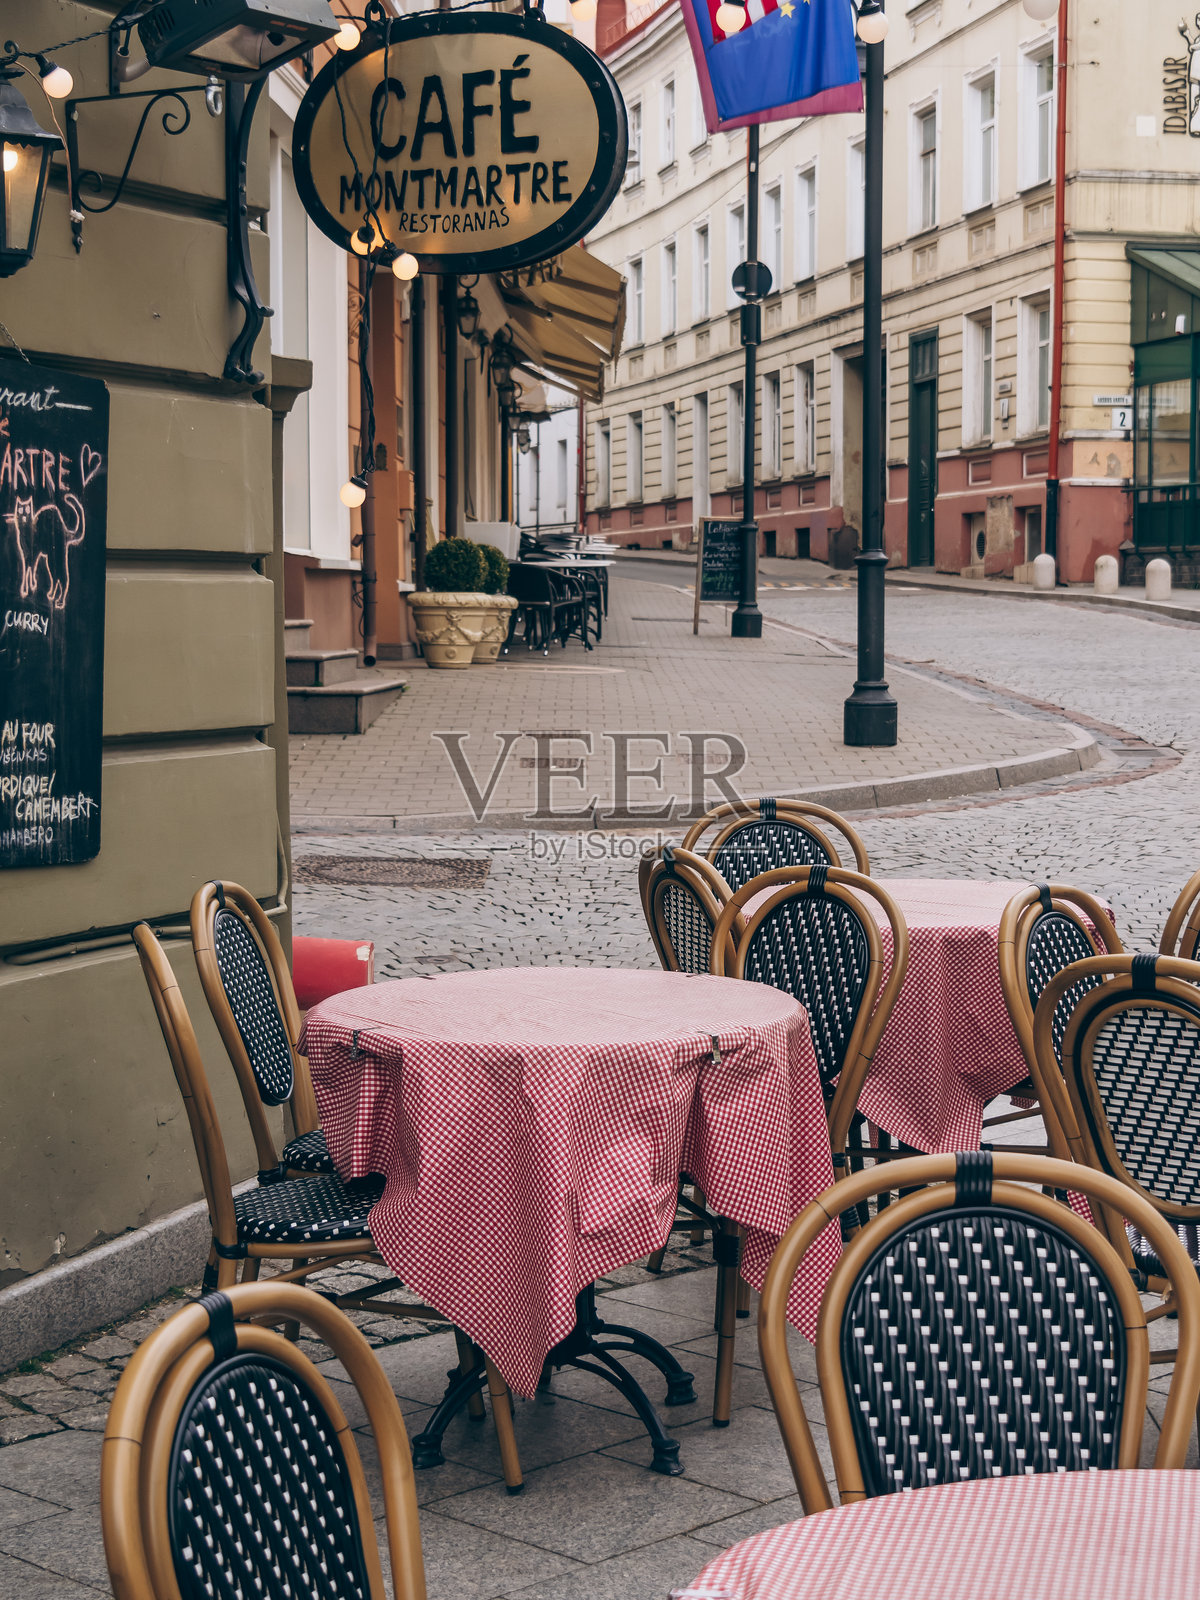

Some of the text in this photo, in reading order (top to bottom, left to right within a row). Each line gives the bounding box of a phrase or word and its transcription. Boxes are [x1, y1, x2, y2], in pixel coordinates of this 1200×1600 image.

[370, 54, 539, 162] CAFÉ
[338, 160, 573, 214] MONTMARTRE
[398, 206, 511, 234] RESTORANAS
[1119, 411, 1126, 428] 2
[4, 610, 49, 636] CURRY
[1, 718, 56, 750] AU FOUR
